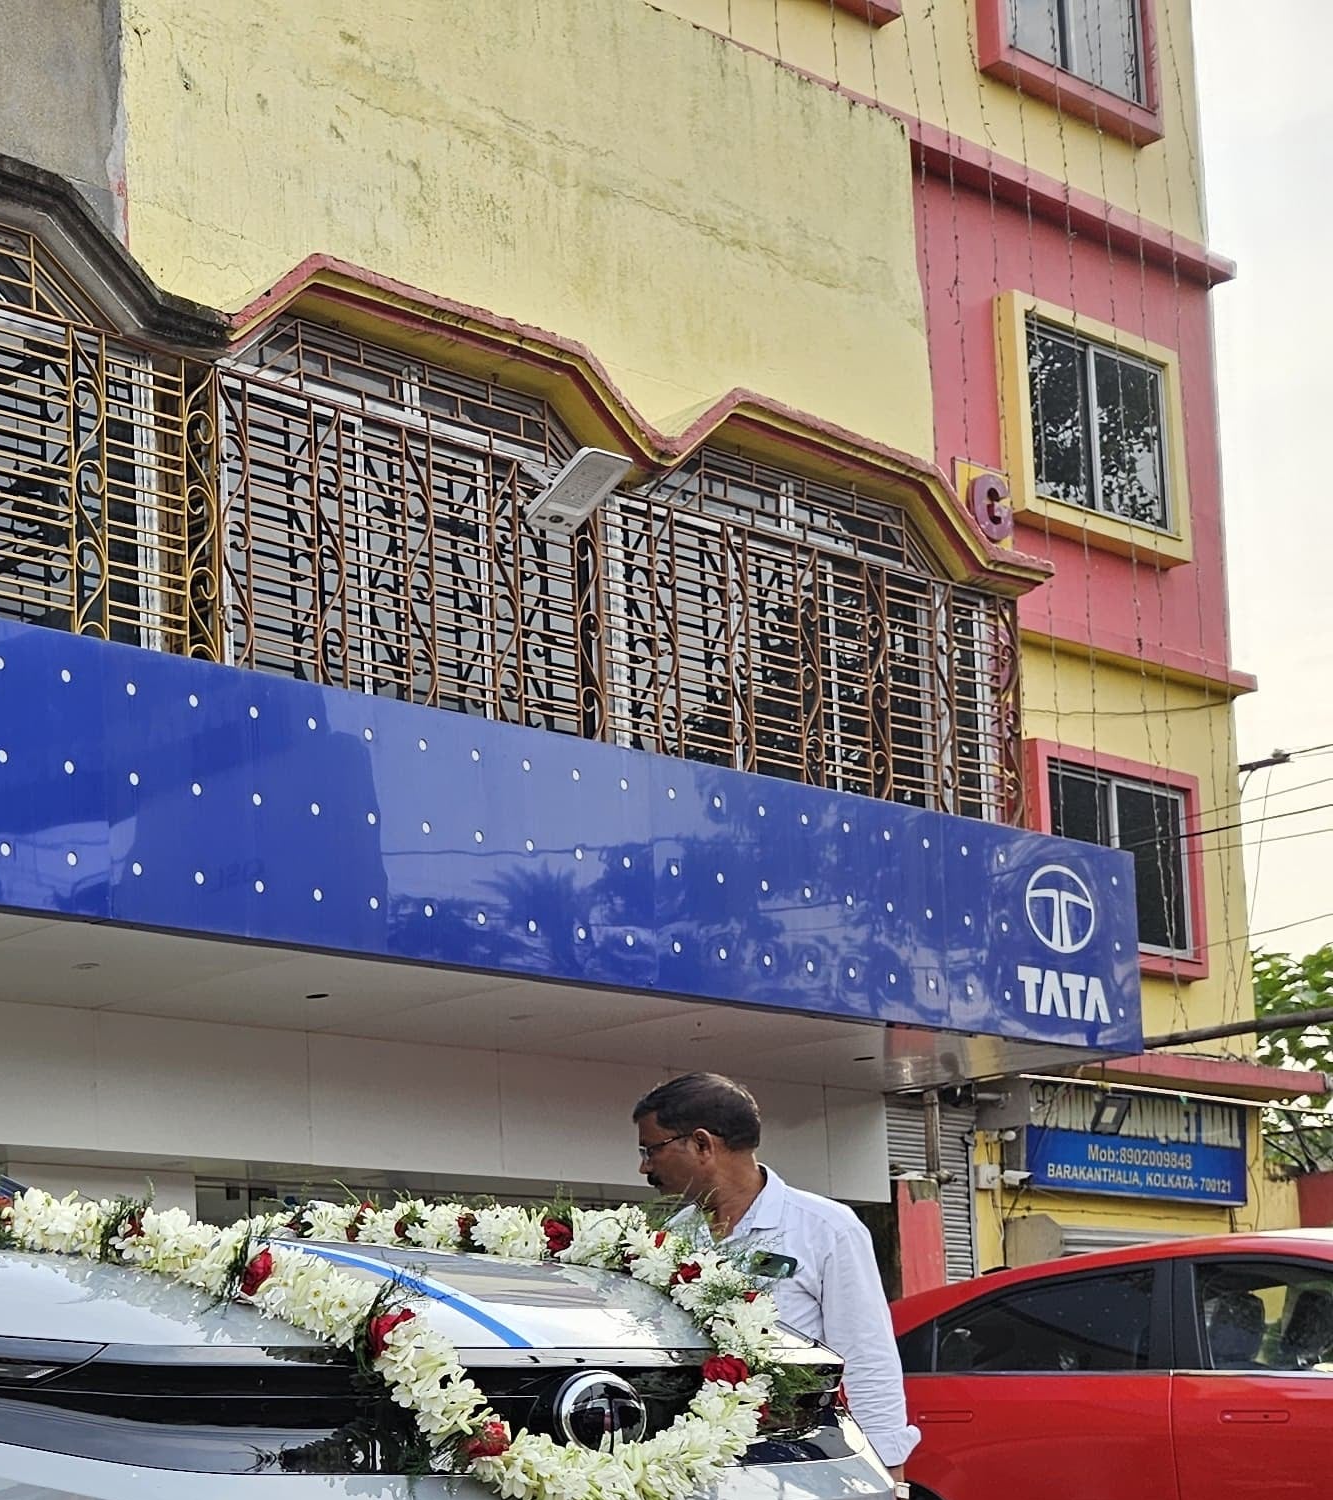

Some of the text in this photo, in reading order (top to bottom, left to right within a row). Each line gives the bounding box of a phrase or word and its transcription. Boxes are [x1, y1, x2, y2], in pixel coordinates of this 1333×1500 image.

[1017, 965, 1111, 1024] TATA
[1201, 1104, 1241, 1148] HALL
[1047, 1163, 1143, 1188] BARAKANTHALIA,
[1200, 1176, 1231, 1193] 700121
